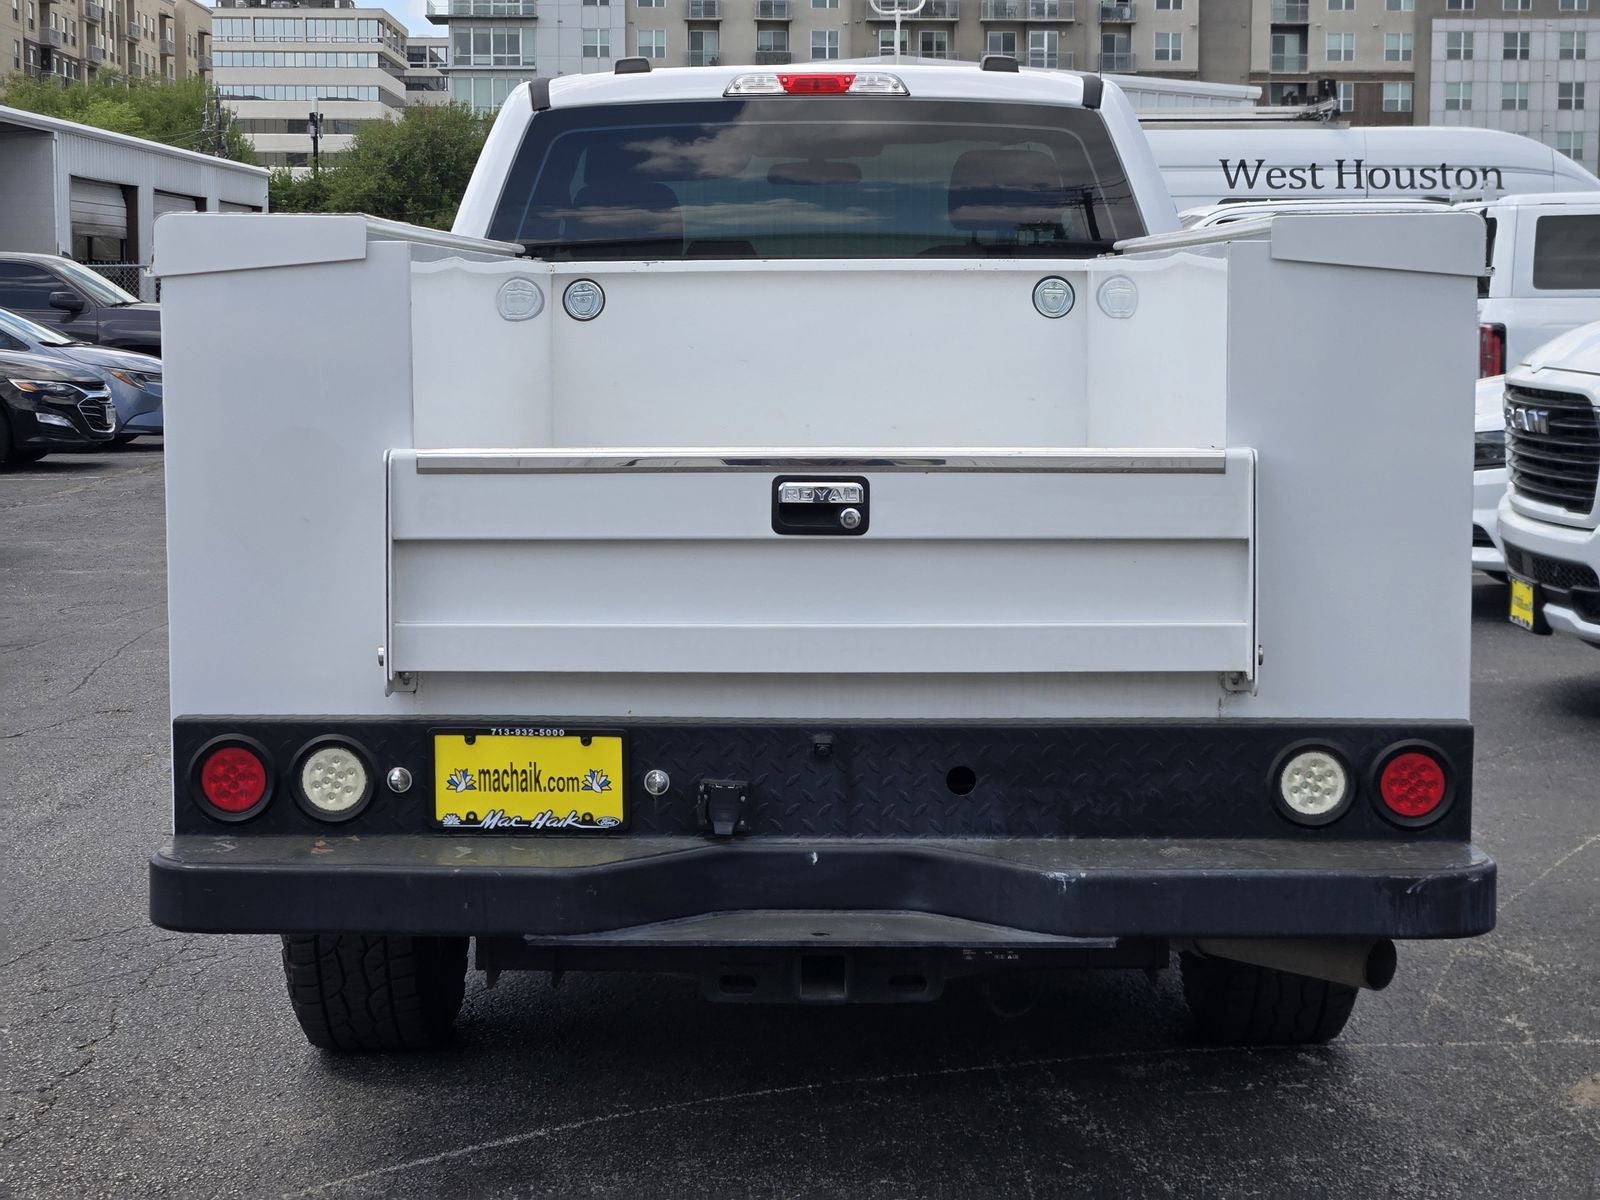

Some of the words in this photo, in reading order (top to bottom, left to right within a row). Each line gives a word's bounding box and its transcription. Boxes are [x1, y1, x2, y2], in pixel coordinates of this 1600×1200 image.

[1219, 158, 1325, 190] West
[1335, 158, 1505, 190] Houston
[1505, 406, 1549, 434] RAM
[784, 487, 858, 501] ROYAL
[490, 728, 565, 737] 713-932-5000
[478, 761, 580, 793] machaik.com
[480, 809, 529, 829] Mac
[530, 809, 582, 829] Haik
